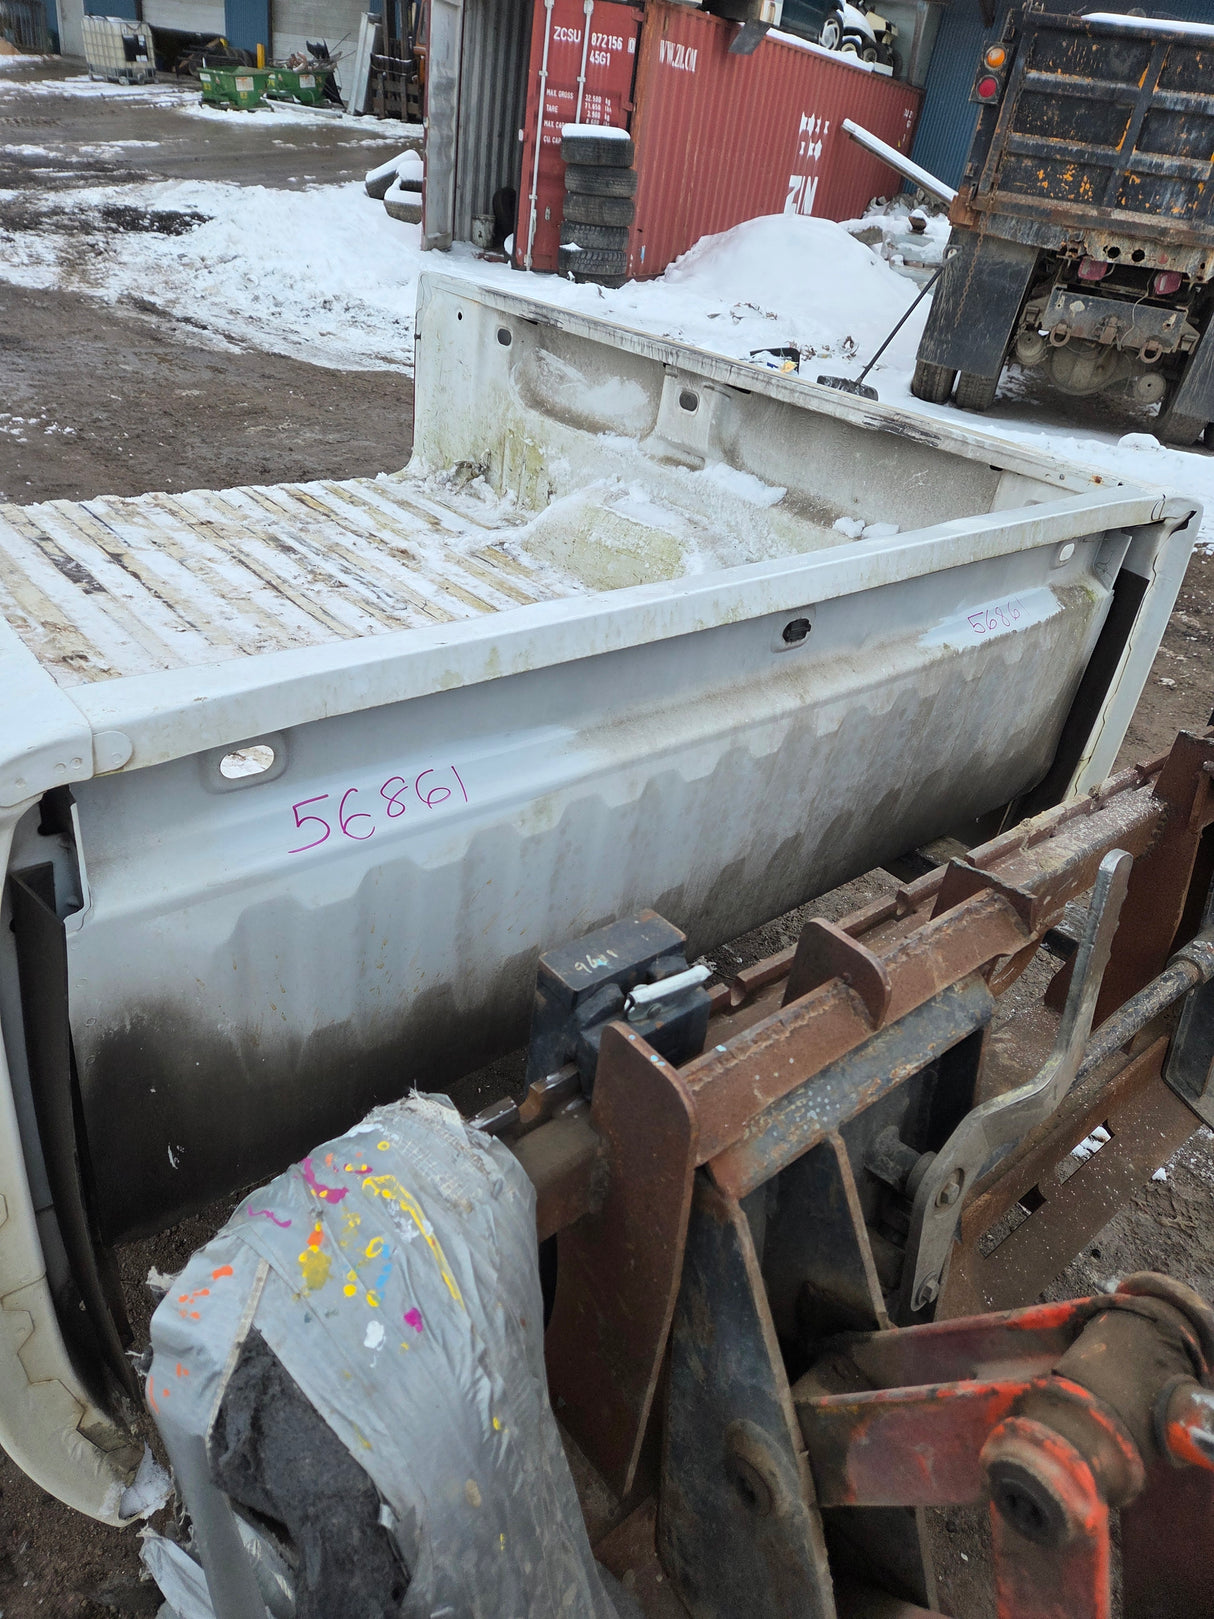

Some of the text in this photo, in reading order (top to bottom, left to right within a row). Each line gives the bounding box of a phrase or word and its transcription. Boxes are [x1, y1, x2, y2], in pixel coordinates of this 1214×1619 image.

[553, 26, 582, 43] ZCSU
[591, 32, 623, 49] 872156
[589, 49, 611, 66] 45G1
[558, 90, 574, 100] GROSS
[546, 103, 559, 113] TARE
[967, 597, 1032, 634] 56861
[287, 765, 469, 854] 56861
